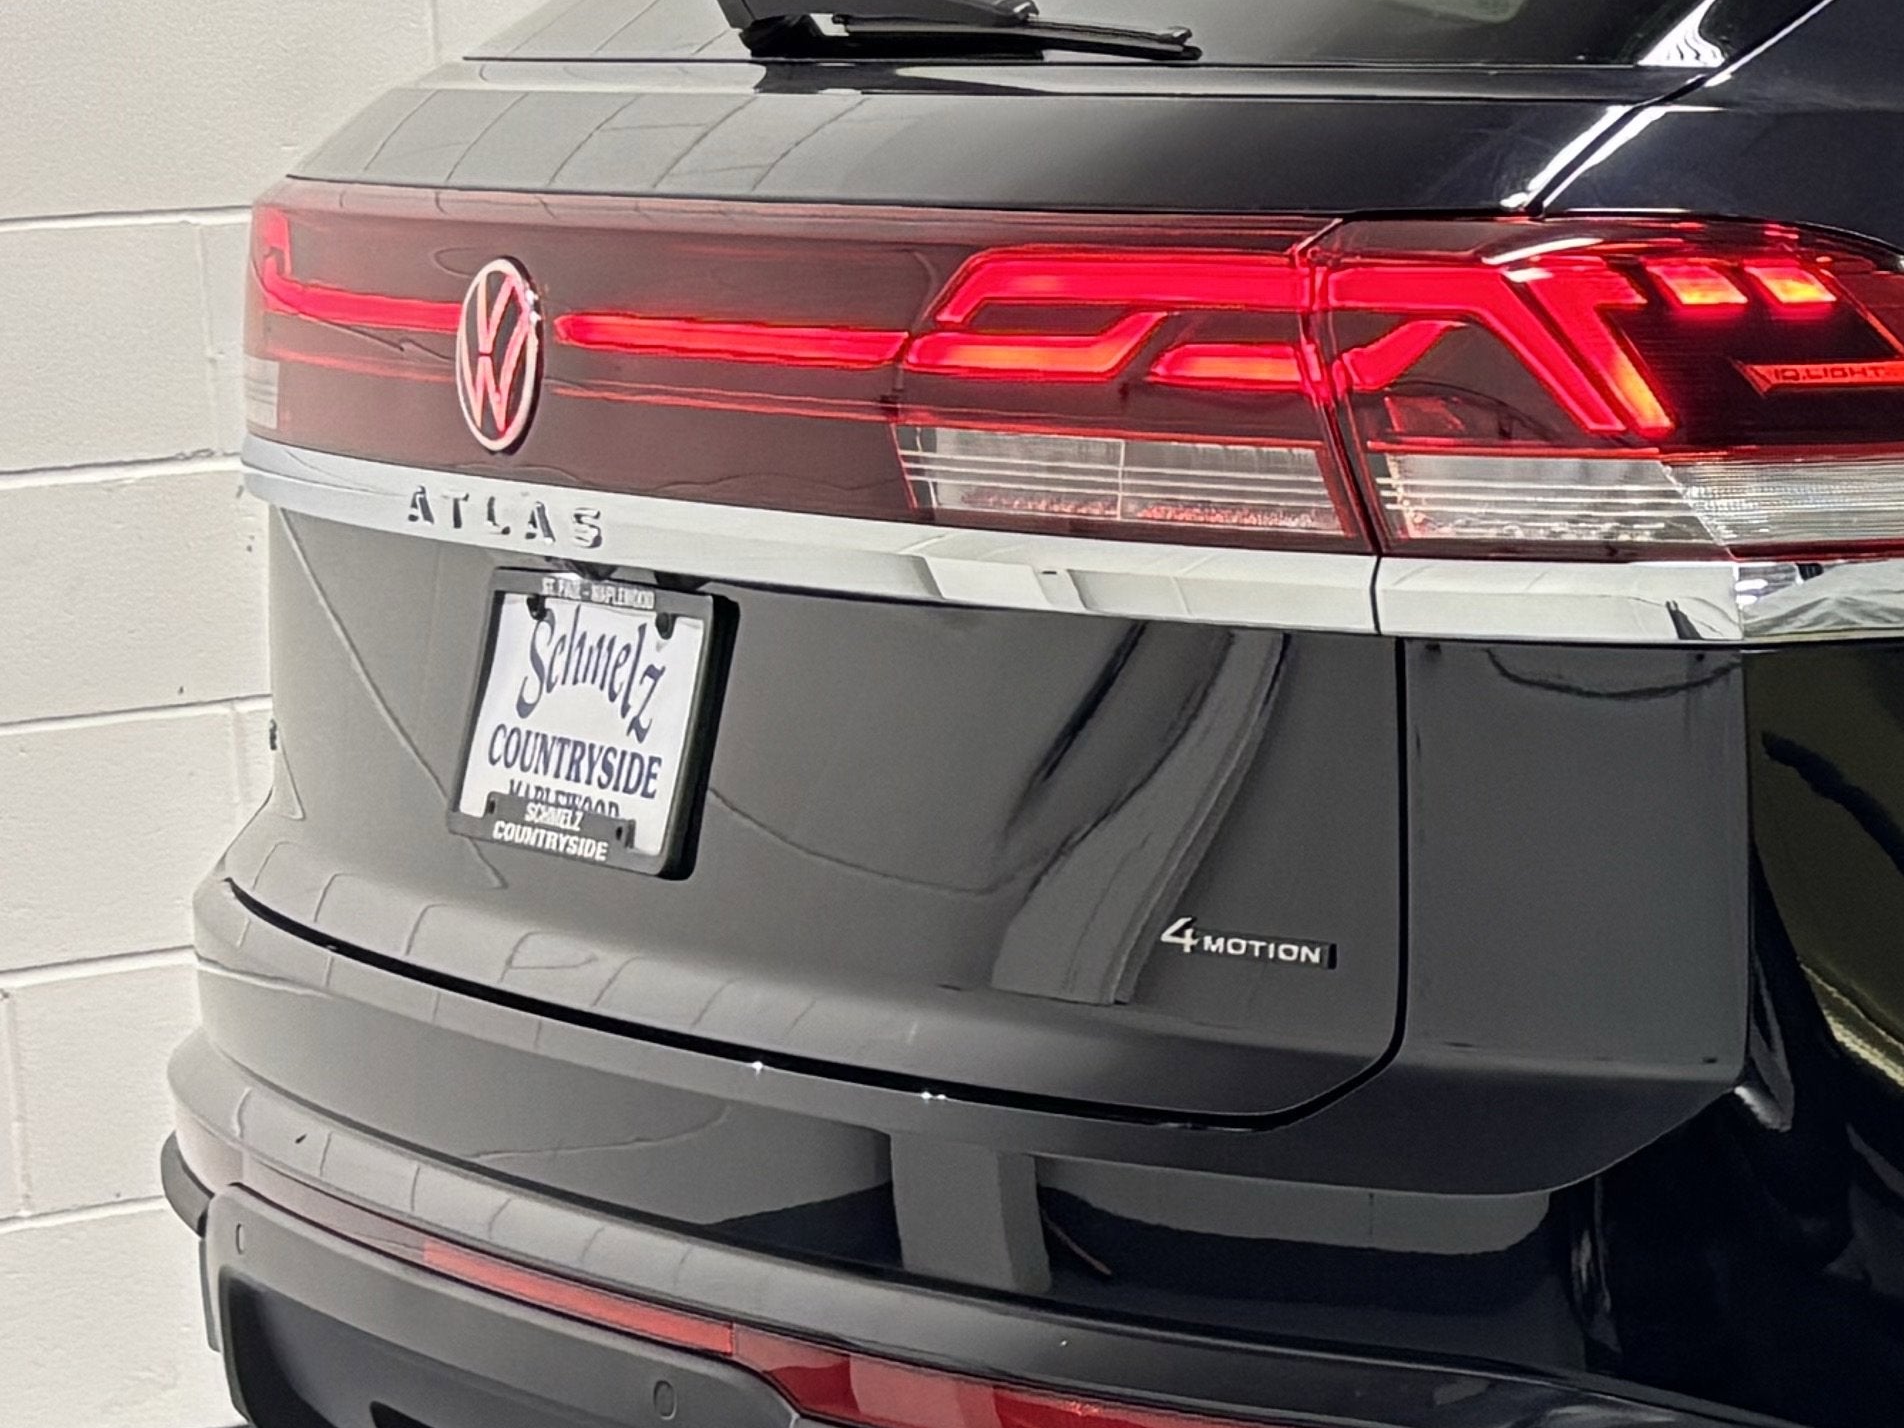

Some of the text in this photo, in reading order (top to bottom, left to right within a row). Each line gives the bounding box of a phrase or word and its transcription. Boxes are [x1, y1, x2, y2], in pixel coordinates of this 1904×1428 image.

[1774, 366, 1884, 381] IQ.LIGHT
[407, 484, 604, 549] ATLAS
[515, 604, 667, 744] Schmelz
[488, 723, 663, 799] COUNTRYSIDE
[492, 820, 609, 862] COUNTRYSIDE
[524, 802, 585, 832] SCHMELZ
[1160, 916, 1321, 964] 4MOTION
